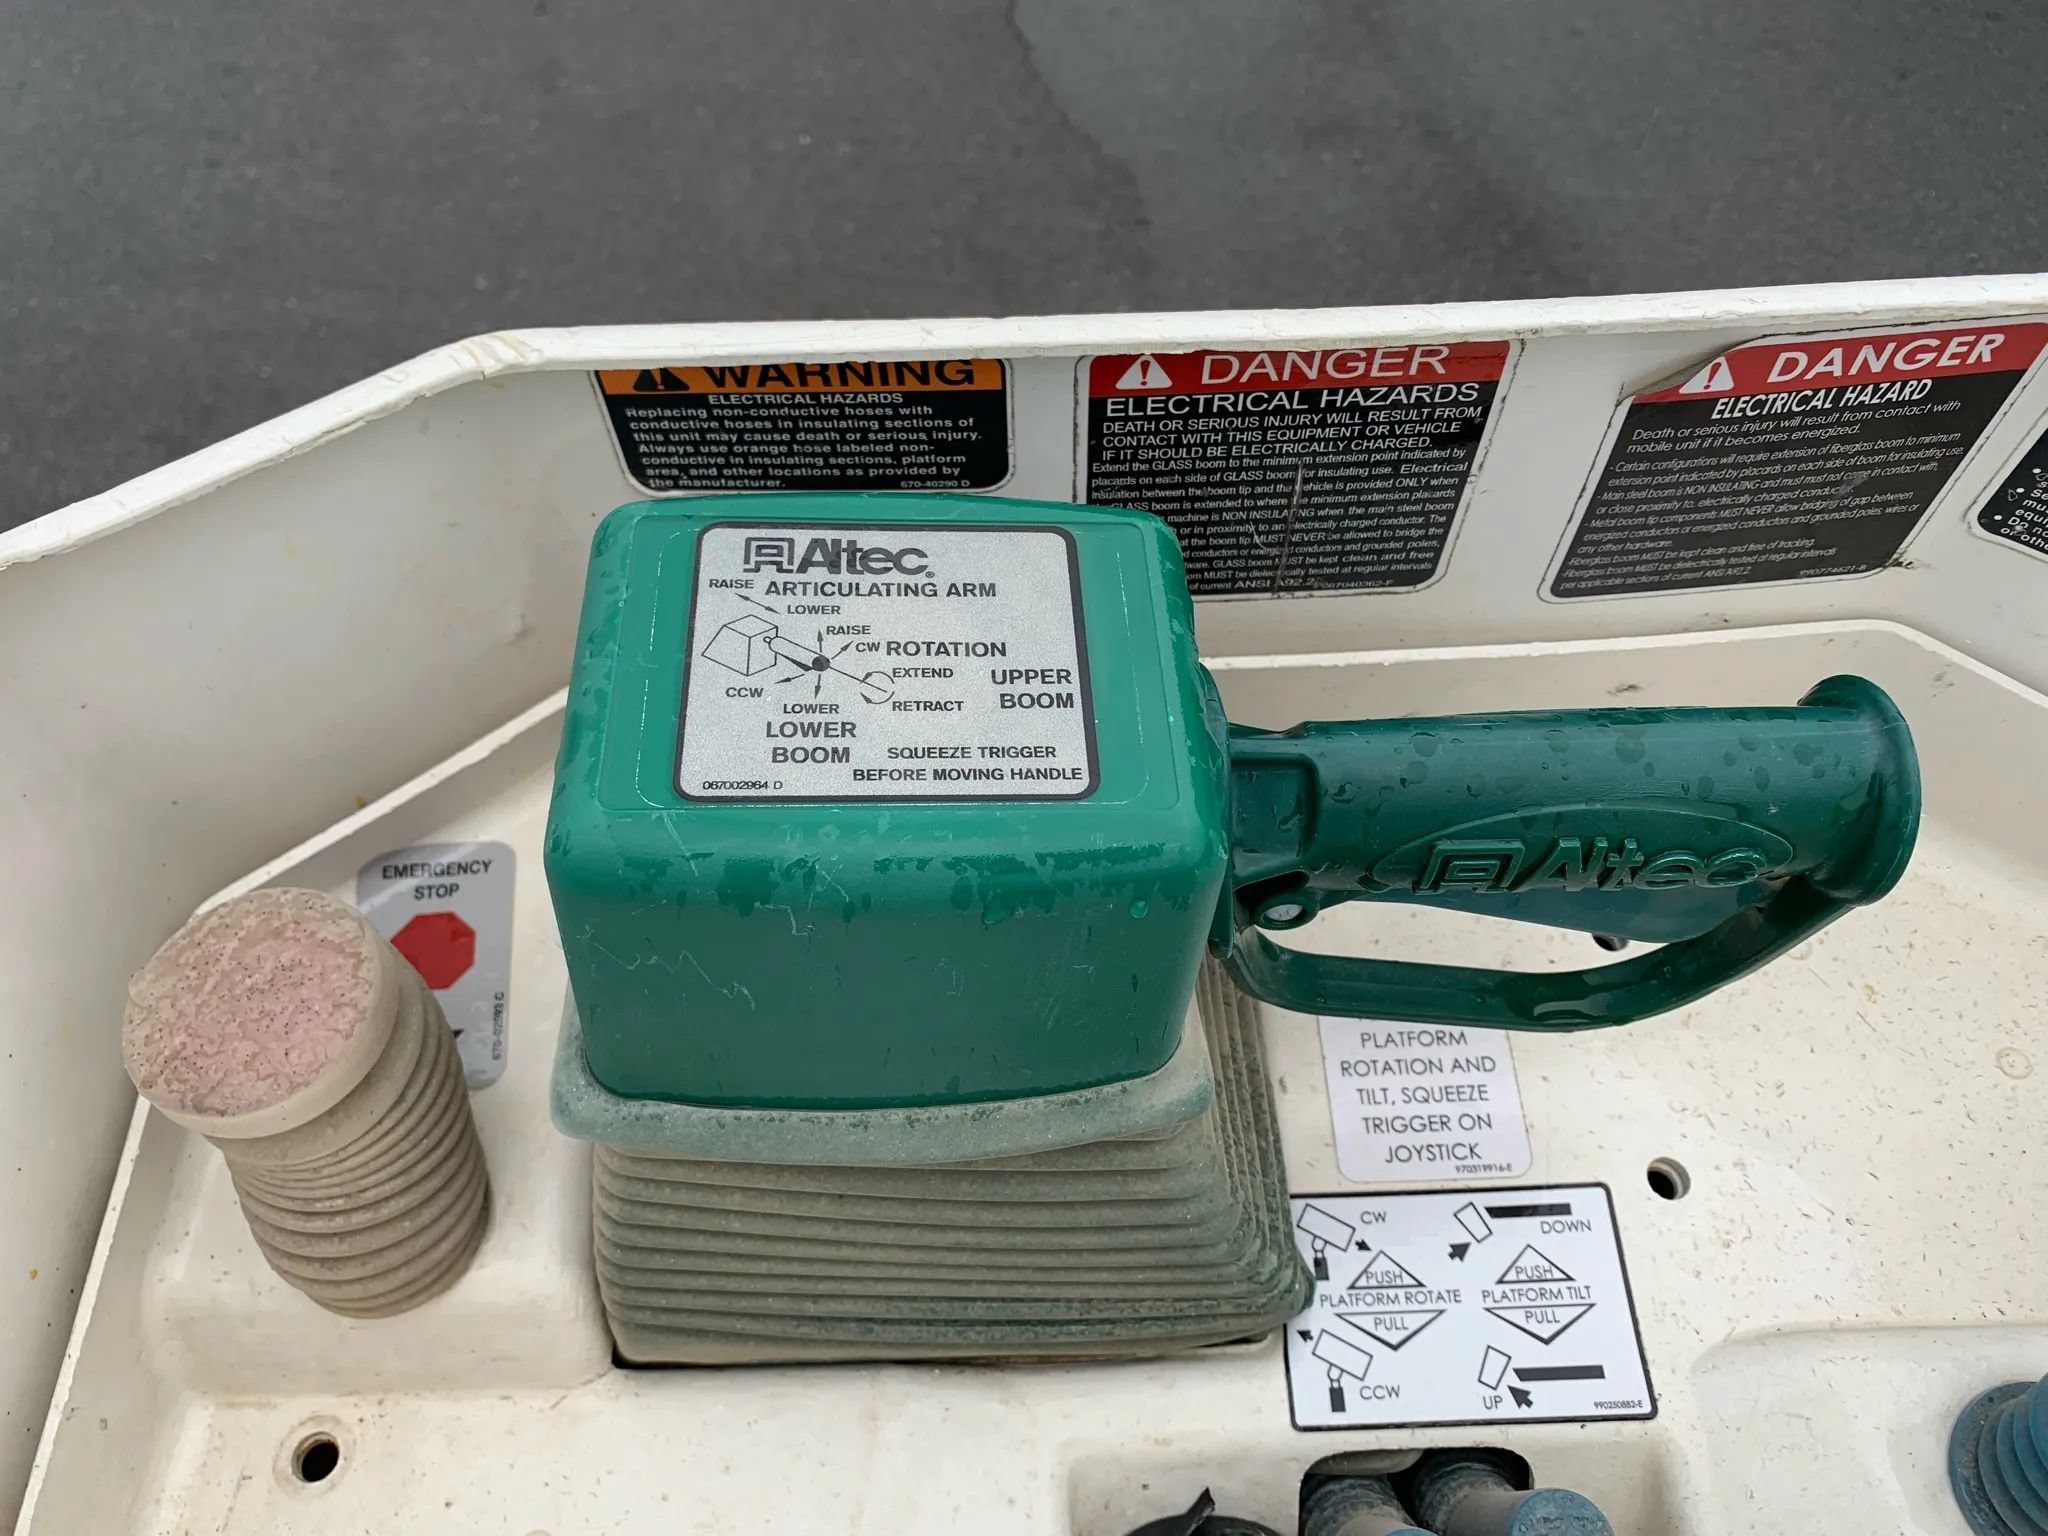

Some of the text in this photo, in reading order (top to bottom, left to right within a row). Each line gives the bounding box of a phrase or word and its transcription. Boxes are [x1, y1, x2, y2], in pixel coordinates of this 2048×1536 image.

[1201, 346, 1450, 385] DANGER
[1767, 333, 2005, 383] DANGER
[703, 360, 974, 388] WARNING
[708, 393, 903, 405] ELECTRICAL HAZARDS
[1106, 383, 1480, 417] ELECTRICAL HAZARDS
[1710, 379, 1932, 420] ELECTRICAL HAZARD
[625, 406, 932, 418] Replacing non-conductive hoses with
[630, 418, 974, 430] conductive hoses in insulating sections of
[1103, 407, 1482, 433] DEATH OR SERIOUS INJURY WILL RESULT FROM
[1632, 400, 1961, 440] Death or serious injury will result from contact with
[634, 433, 664, 441] this
[670, 433, 700, 441] unit
[706, 433, 737, 442] may
[744, 433, 790, 441] cause
[796, 432, 840, 440] death
[868, 431, 928, 440] serious
[933, 431, 982, 441] injury.
[1103, 422, 1462, 447] CONTACT WITH THIS EQUIPMENT OR VEHICLE
[1627, 424, 1861, 453] mobile unit if it becomes energized.
[639, 445, 694, 454] Always
[734, 446, 792, 454] orange
[794, 444, 831, 453] hose
[836, 444, 893, 452] labeled
[900, 444, 934, 452] non-
[1103, 437, 1433, 460] IF IT SHOULD BE ELECTRICALLY CHARGED.
[642, 456, 725, 465] conductive
[730, 456, 744, 464] in
[749, 455, 823, 466] insulating
[902, 455, 966, 465] platform
[1093, 448, 1466, 473] Extend the GLASS boom to the extension point indicated by
[690, 467, 717, 476] and
[723, 467, 762, 475] other
[768, 467, 840, 476] locations
[869, 467, 937, 477] provided
[943, 467, 960, 477] by
[1092, 476, 1136, 487] placards
[1155, 474, 1181, 483] each
[1185, 473, 1207, 482] side
[1209, 473, 1221, 481] of
[1223, 471, 1263, 482] GLASS
[1266, 470, 1295, 479] boom
[1318, 465, 1368, 477] insulating
[1400, 463, 1468, 474] Electrical
[649, 478, 786, 487] the manufacturer.
[797, 538, 929, 575] Altec
[709, 579, 754, 589] RAISE
[765, 582, 997, 597] ARTICULATING ARM
[787, 605, 841, 615] LOWER
[826, 626, 871, 635] RAISE
[856, 643, 880, 653] CW
[887, 642, 1006, 657] ROTATION
[892, 668, 954, 678] EXTEND
[991, 670, 1072, 685] UPPER
[725, 687, 764, 698] CCW
[892, 701, 964, 711] RETRACT
[1000, 693, 1074, 709] BOOM
[783, 704, 839, 714] LOWER
[766, 721, 857, 738] LOWER
[772, 747, 850, 764] BOOM
[888, 747, 1056, 759] SQUEEZE TRIGGER
[853, 768, 1082, 781] BEFORE MOVING HANDLE
[382, 861, 492, 880] EMERGENCY
[1516, 837, 1768, 892] Altec
[414, 883, 459, 901] STOP
[1360, 1030, 1467, 1047] PLATFORM
[1341, 1057, 1496, 1077] ROTATION AND
[1356, 1085, 1489, 1106] TILT, SQUEEZE
[1363, 1113, 1492, 1135] TRIGGER ON
[1384, 1144, 1481, 1163] JOYSTICK
[1360, 1211, 1387, 1224] CW
[1540, 1220, 1592, 1234] DOWN
[1365, 1271, 1403, 1285] PUSH
[1515, 1266, 1554, 1279] PUSH
[1320, 1290, 1462, 1308] PLATFORM ROTATE
[1482, 1286, 1592, 1304] PLATFORM TILT
[1374, 1317, 1409, 1331] PULL
[1525, 1310, 1561, 1324] PULL
[1360, 1386, 1400, 1400] CCW
[1483, 1396, 1503, 1410] UP
